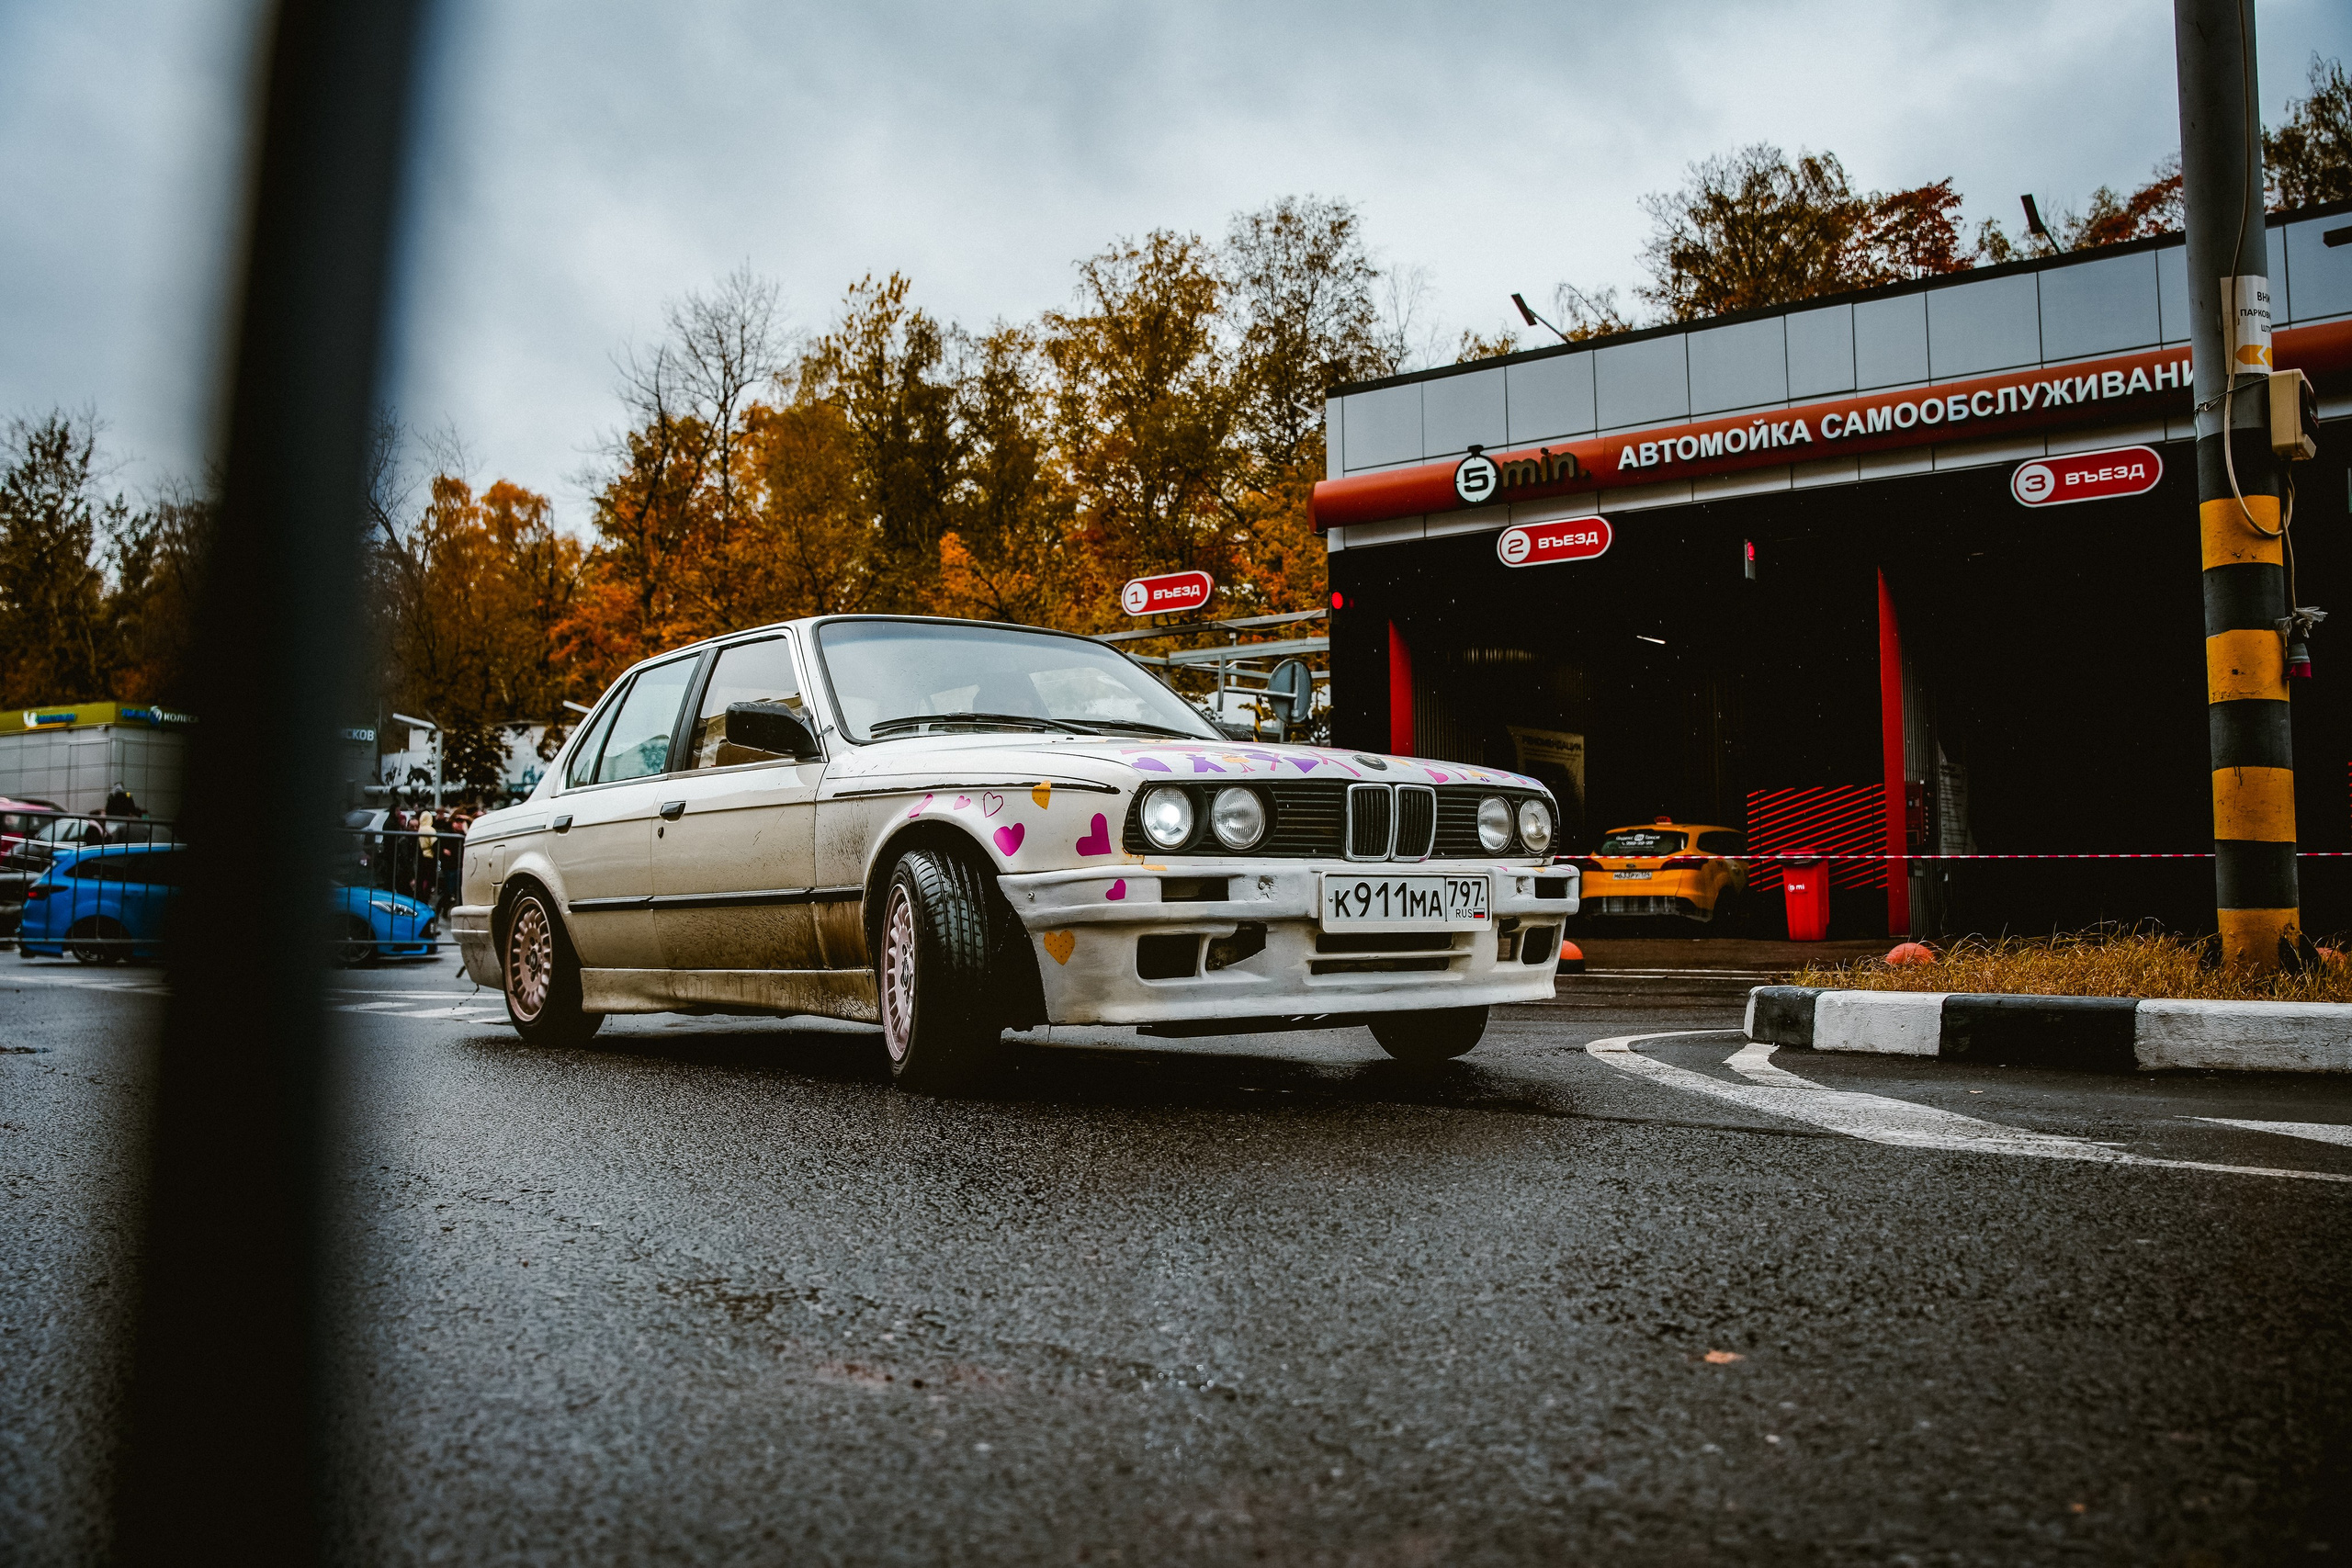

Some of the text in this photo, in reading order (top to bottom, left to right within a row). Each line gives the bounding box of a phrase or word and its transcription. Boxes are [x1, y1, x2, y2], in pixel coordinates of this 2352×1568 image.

[1617, 418, 1813, 470] АВТОМОЙКА
[1463, 465, 1489, 493] 5
[2024, 463, 2145, 493] 3 ВЪЕЗД
[1507, 531, 1599, 555] 2 ВЪЕЗД
[1130, 584, 1201, 604] 1 ВЪЕЗД
[1334, 880, 1482, 918] К911МА 797
[1455, 908, 1473, 919] RUS
